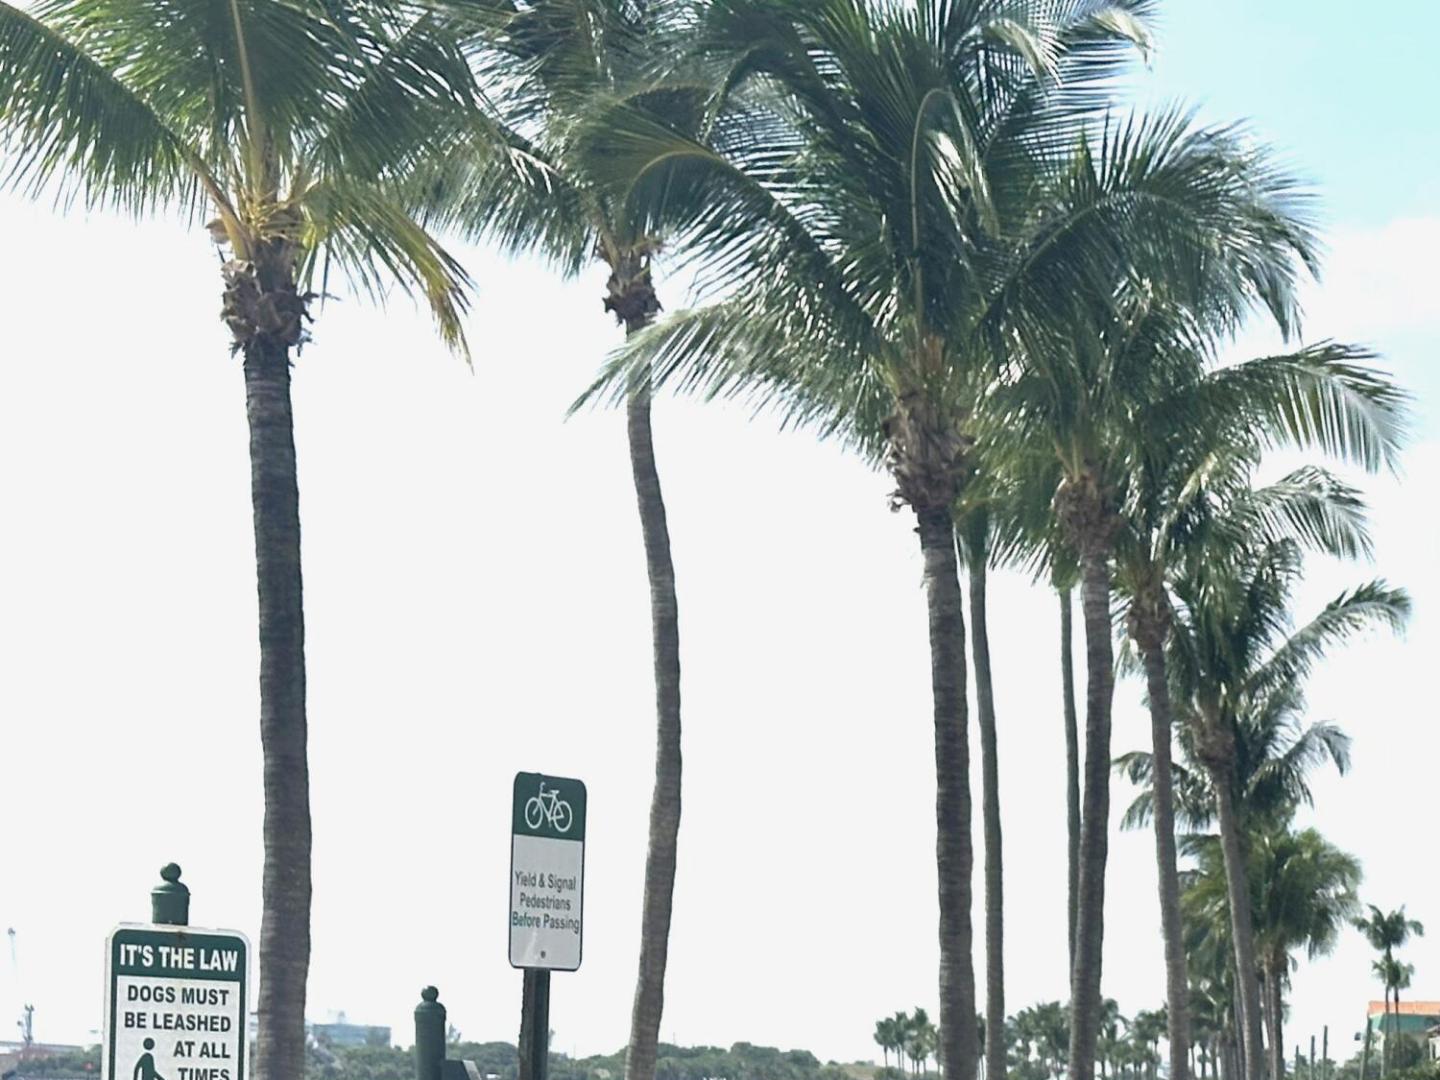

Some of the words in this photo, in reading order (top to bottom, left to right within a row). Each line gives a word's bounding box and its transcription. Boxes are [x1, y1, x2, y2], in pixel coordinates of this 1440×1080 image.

[515, 871, 537, 888] Yield
[539, 873, 545, 888] &
[547, 874, 576, 893] Signal
[520, 892, 571, 911] Pedestrians
[512, 911, 541, 929] Before
[543, 914, 580, 935] Passing
[119, 943, 153, 967] IT'S
[159, 946, 194, 969] THE
[200, 949, 238, 972] LAW
[127, 985, 175, 1002] DOGS
[181, 987, 229, 1006] MUST
[124, 1012, 147, 1028] BE
[153, 1013, 231, 1032] LEASHED
[173, 1041, 195, 1058] AT
[199, 1042, 231, 1059] ALL
